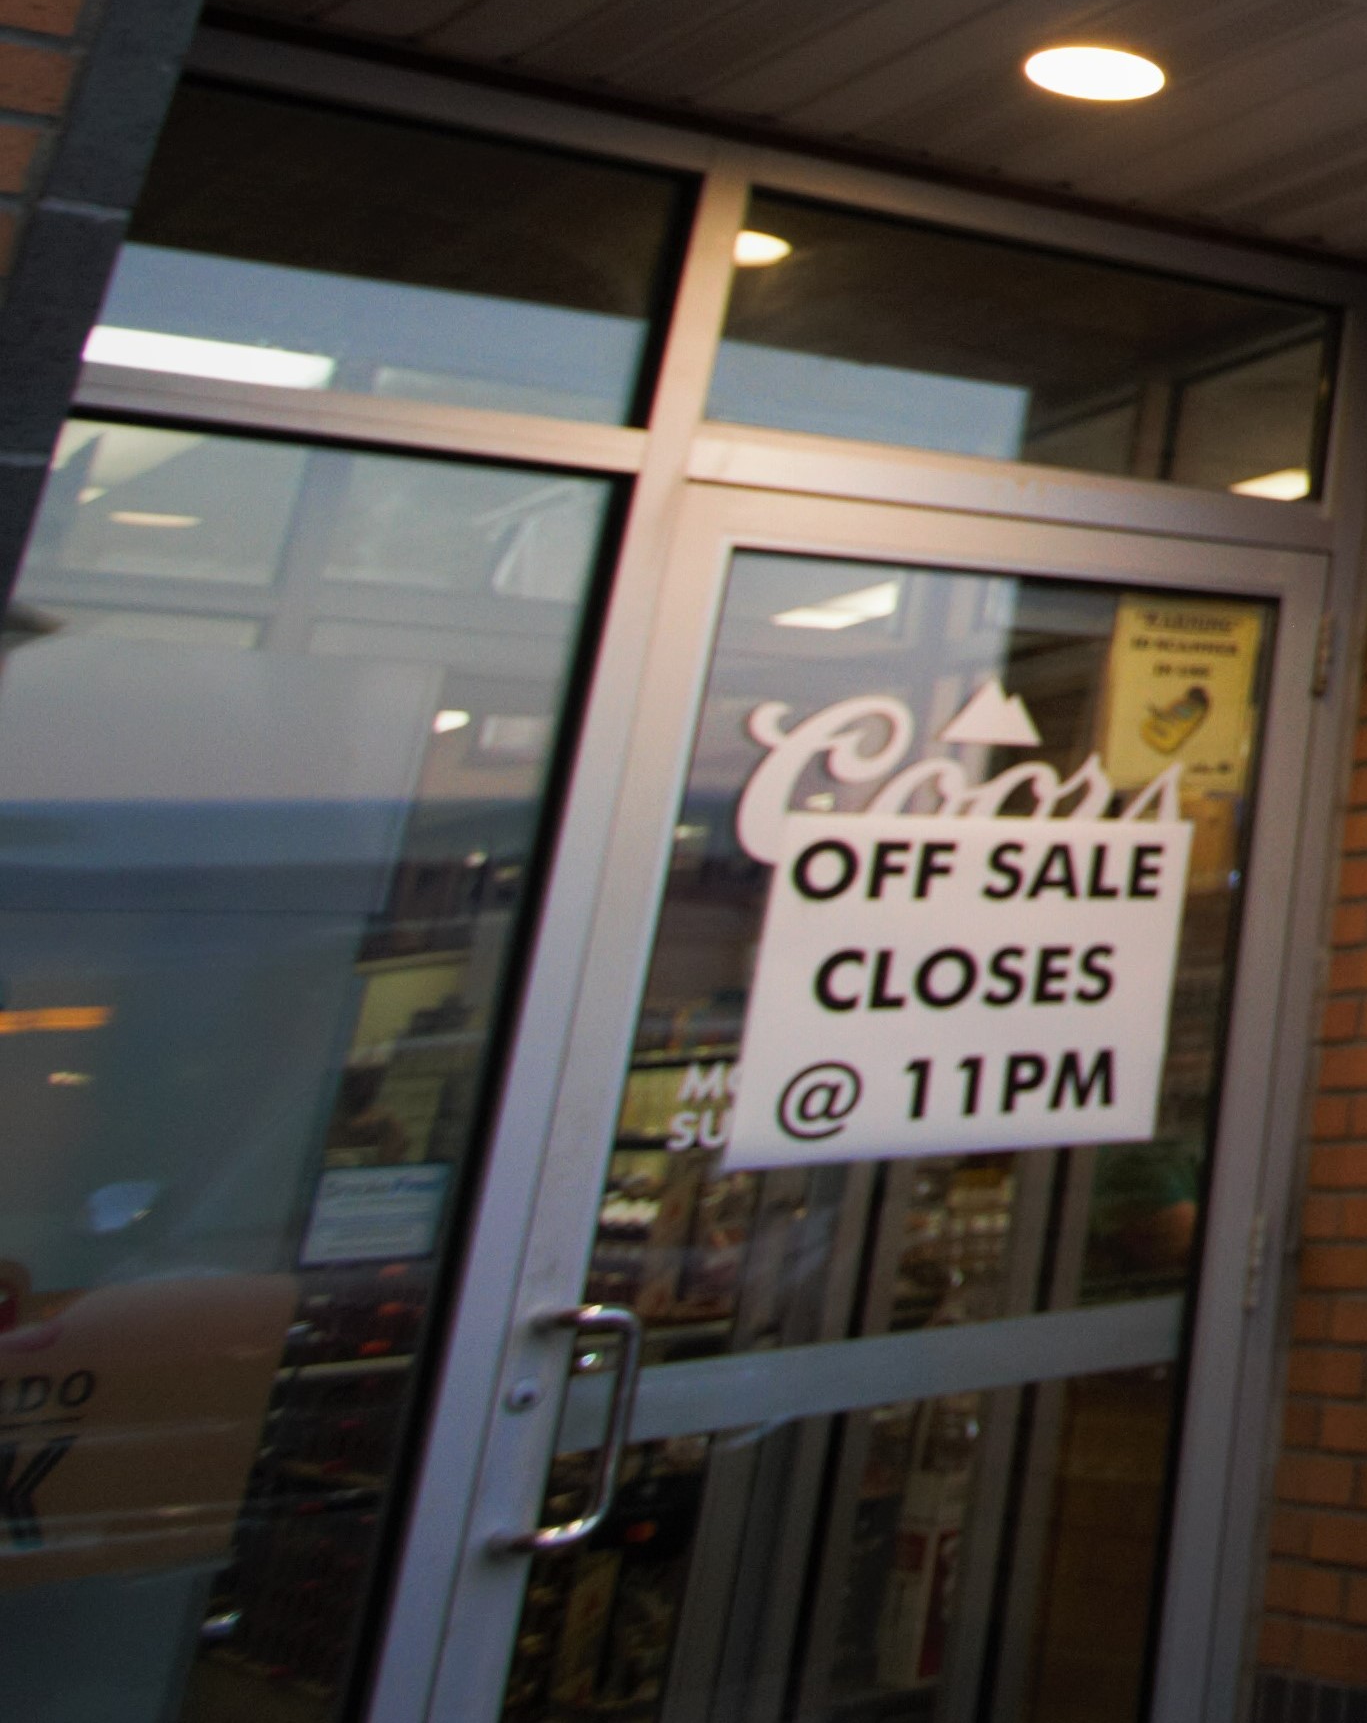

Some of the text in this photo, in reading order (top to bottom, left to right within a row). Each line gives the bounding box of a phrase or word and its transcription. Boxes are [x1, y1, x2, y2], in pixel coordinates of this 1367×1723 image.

[792, 838, 1165, 902] OFF SALE
[813, 944, 1115, 1013] CLOSES
[776, 1047, 1115, 1141] @ 11PM
